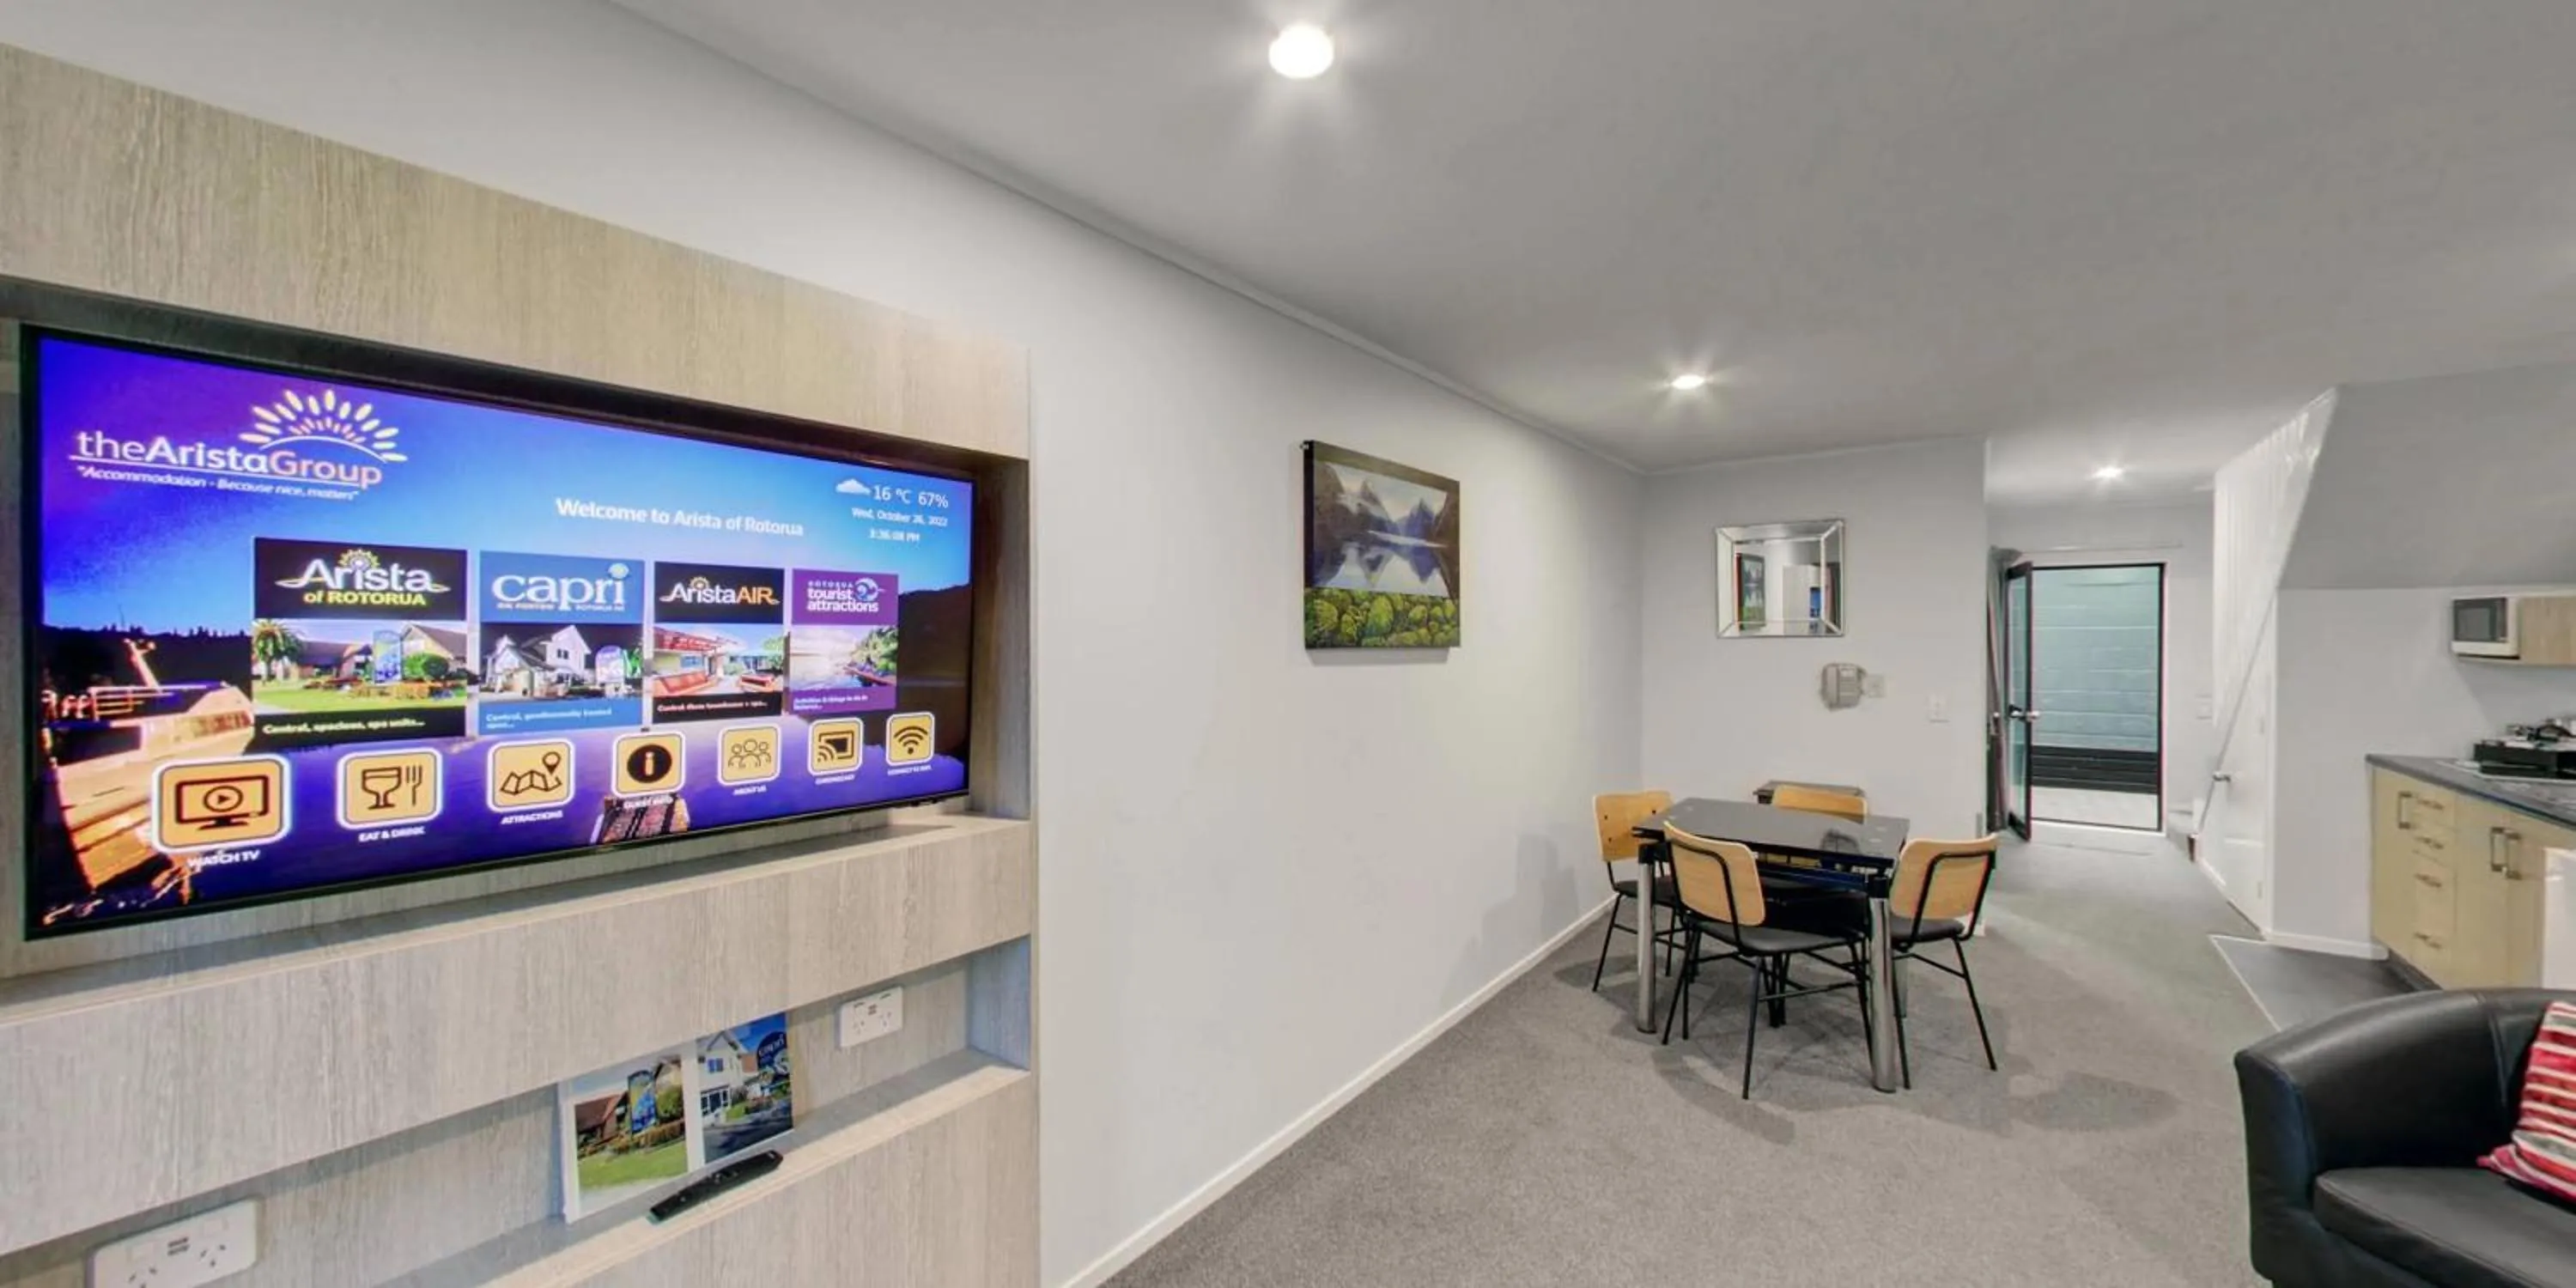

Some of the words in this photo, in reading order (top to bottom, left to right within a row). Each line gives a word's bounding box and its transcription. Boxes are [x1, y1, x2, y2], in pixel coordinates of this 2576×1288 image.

[76, 430, 383, 489] theAristaGroup
[216, 477, 274, 495] Because
[873, 484, 891, 501] 16
[918, 490, 949, 508] 67%
[555, 497, 648, 523] Welcome
[651, 507, 670, 526] to
[673, 509, 721, 530] Arista
[725, 514, 742, 532] of
[744, 516, 805, 537] Rotorua
[297, 556, 433, 593] Arista
[491, 562, 626, 612] capri
[667, 581, 774, 605] AristaAIR
[806, 586, 854, 600] tourist
[303, 591, 325, 605] of
[327, 592, 428, 606] ROTORUA
[806, 598, 879, 612] attractions
[501, 810, 564, 825] ATTRACTIONS
[358, 830, 380, 842] EAT
[391, 825, 427, 838] DRINK
[187, 852, 240, 868] WATCH
[241, 848, 261, 862] TV
